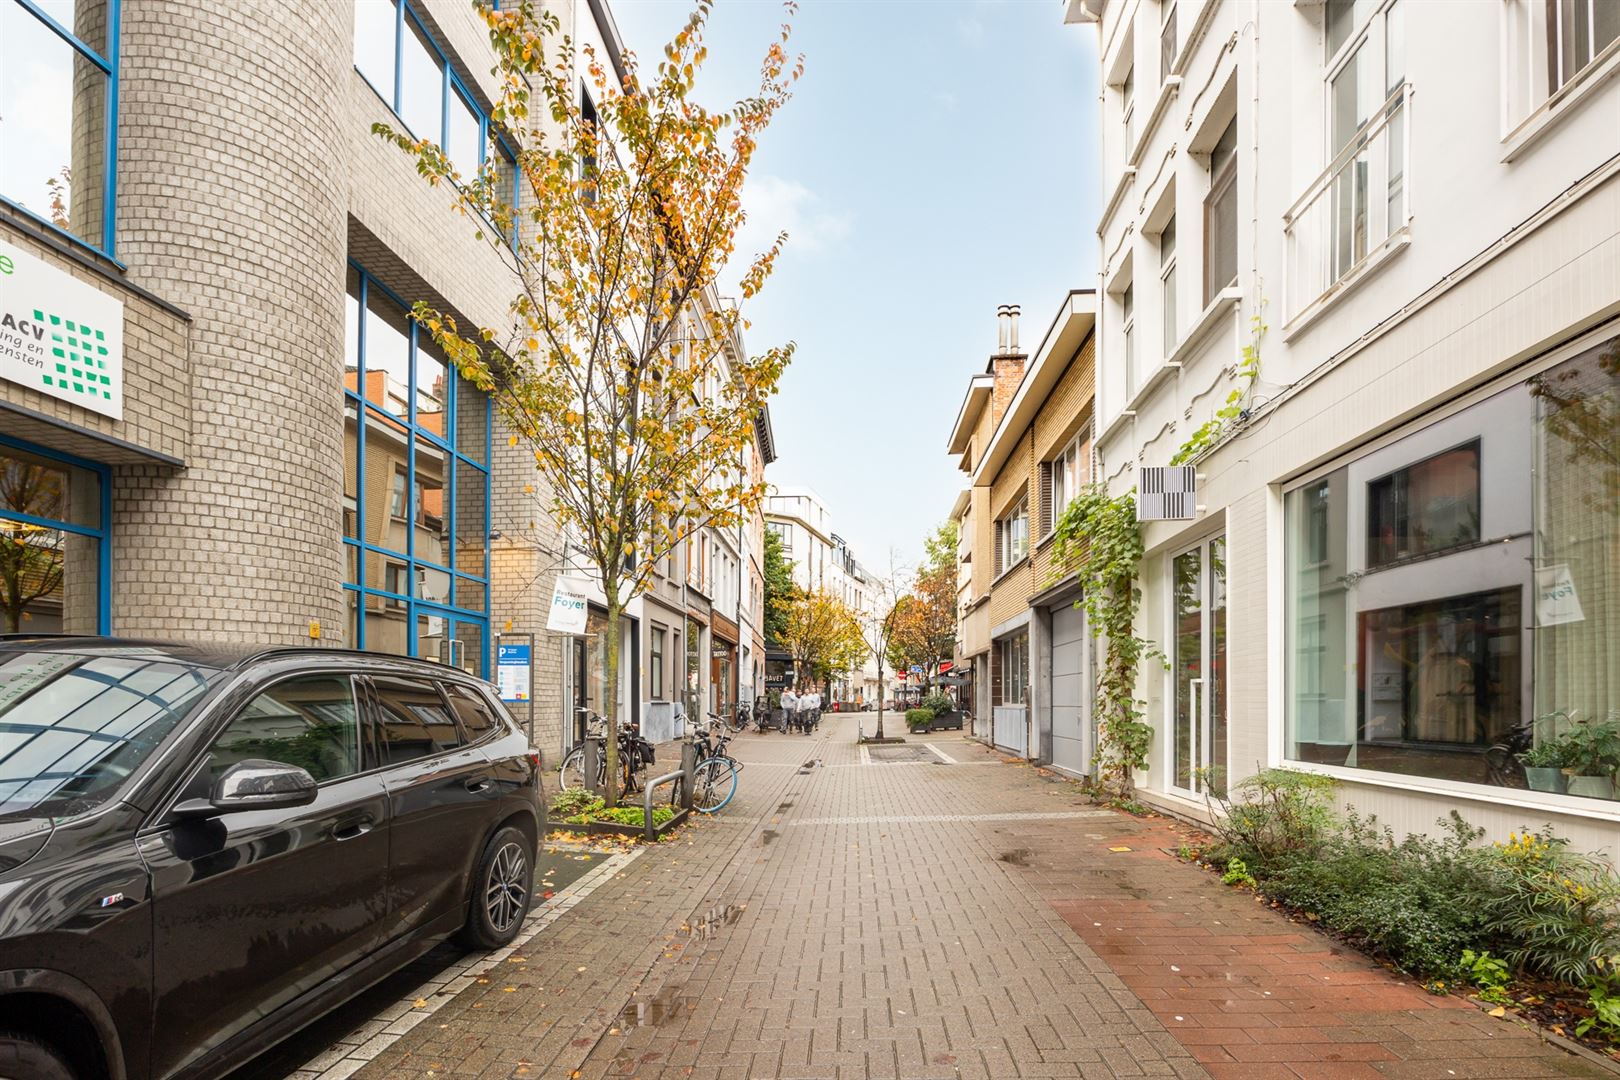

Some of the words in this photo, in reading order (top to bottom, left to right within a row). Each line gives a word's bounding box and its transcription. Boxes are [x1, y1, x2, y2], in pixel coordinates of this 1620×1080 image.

[2, 313, 45, 341] ACV
[27, 343, 44, 355] en
[556, 589, 586, 599] Restaurant
[554, 595, 585, 610] Foyer
